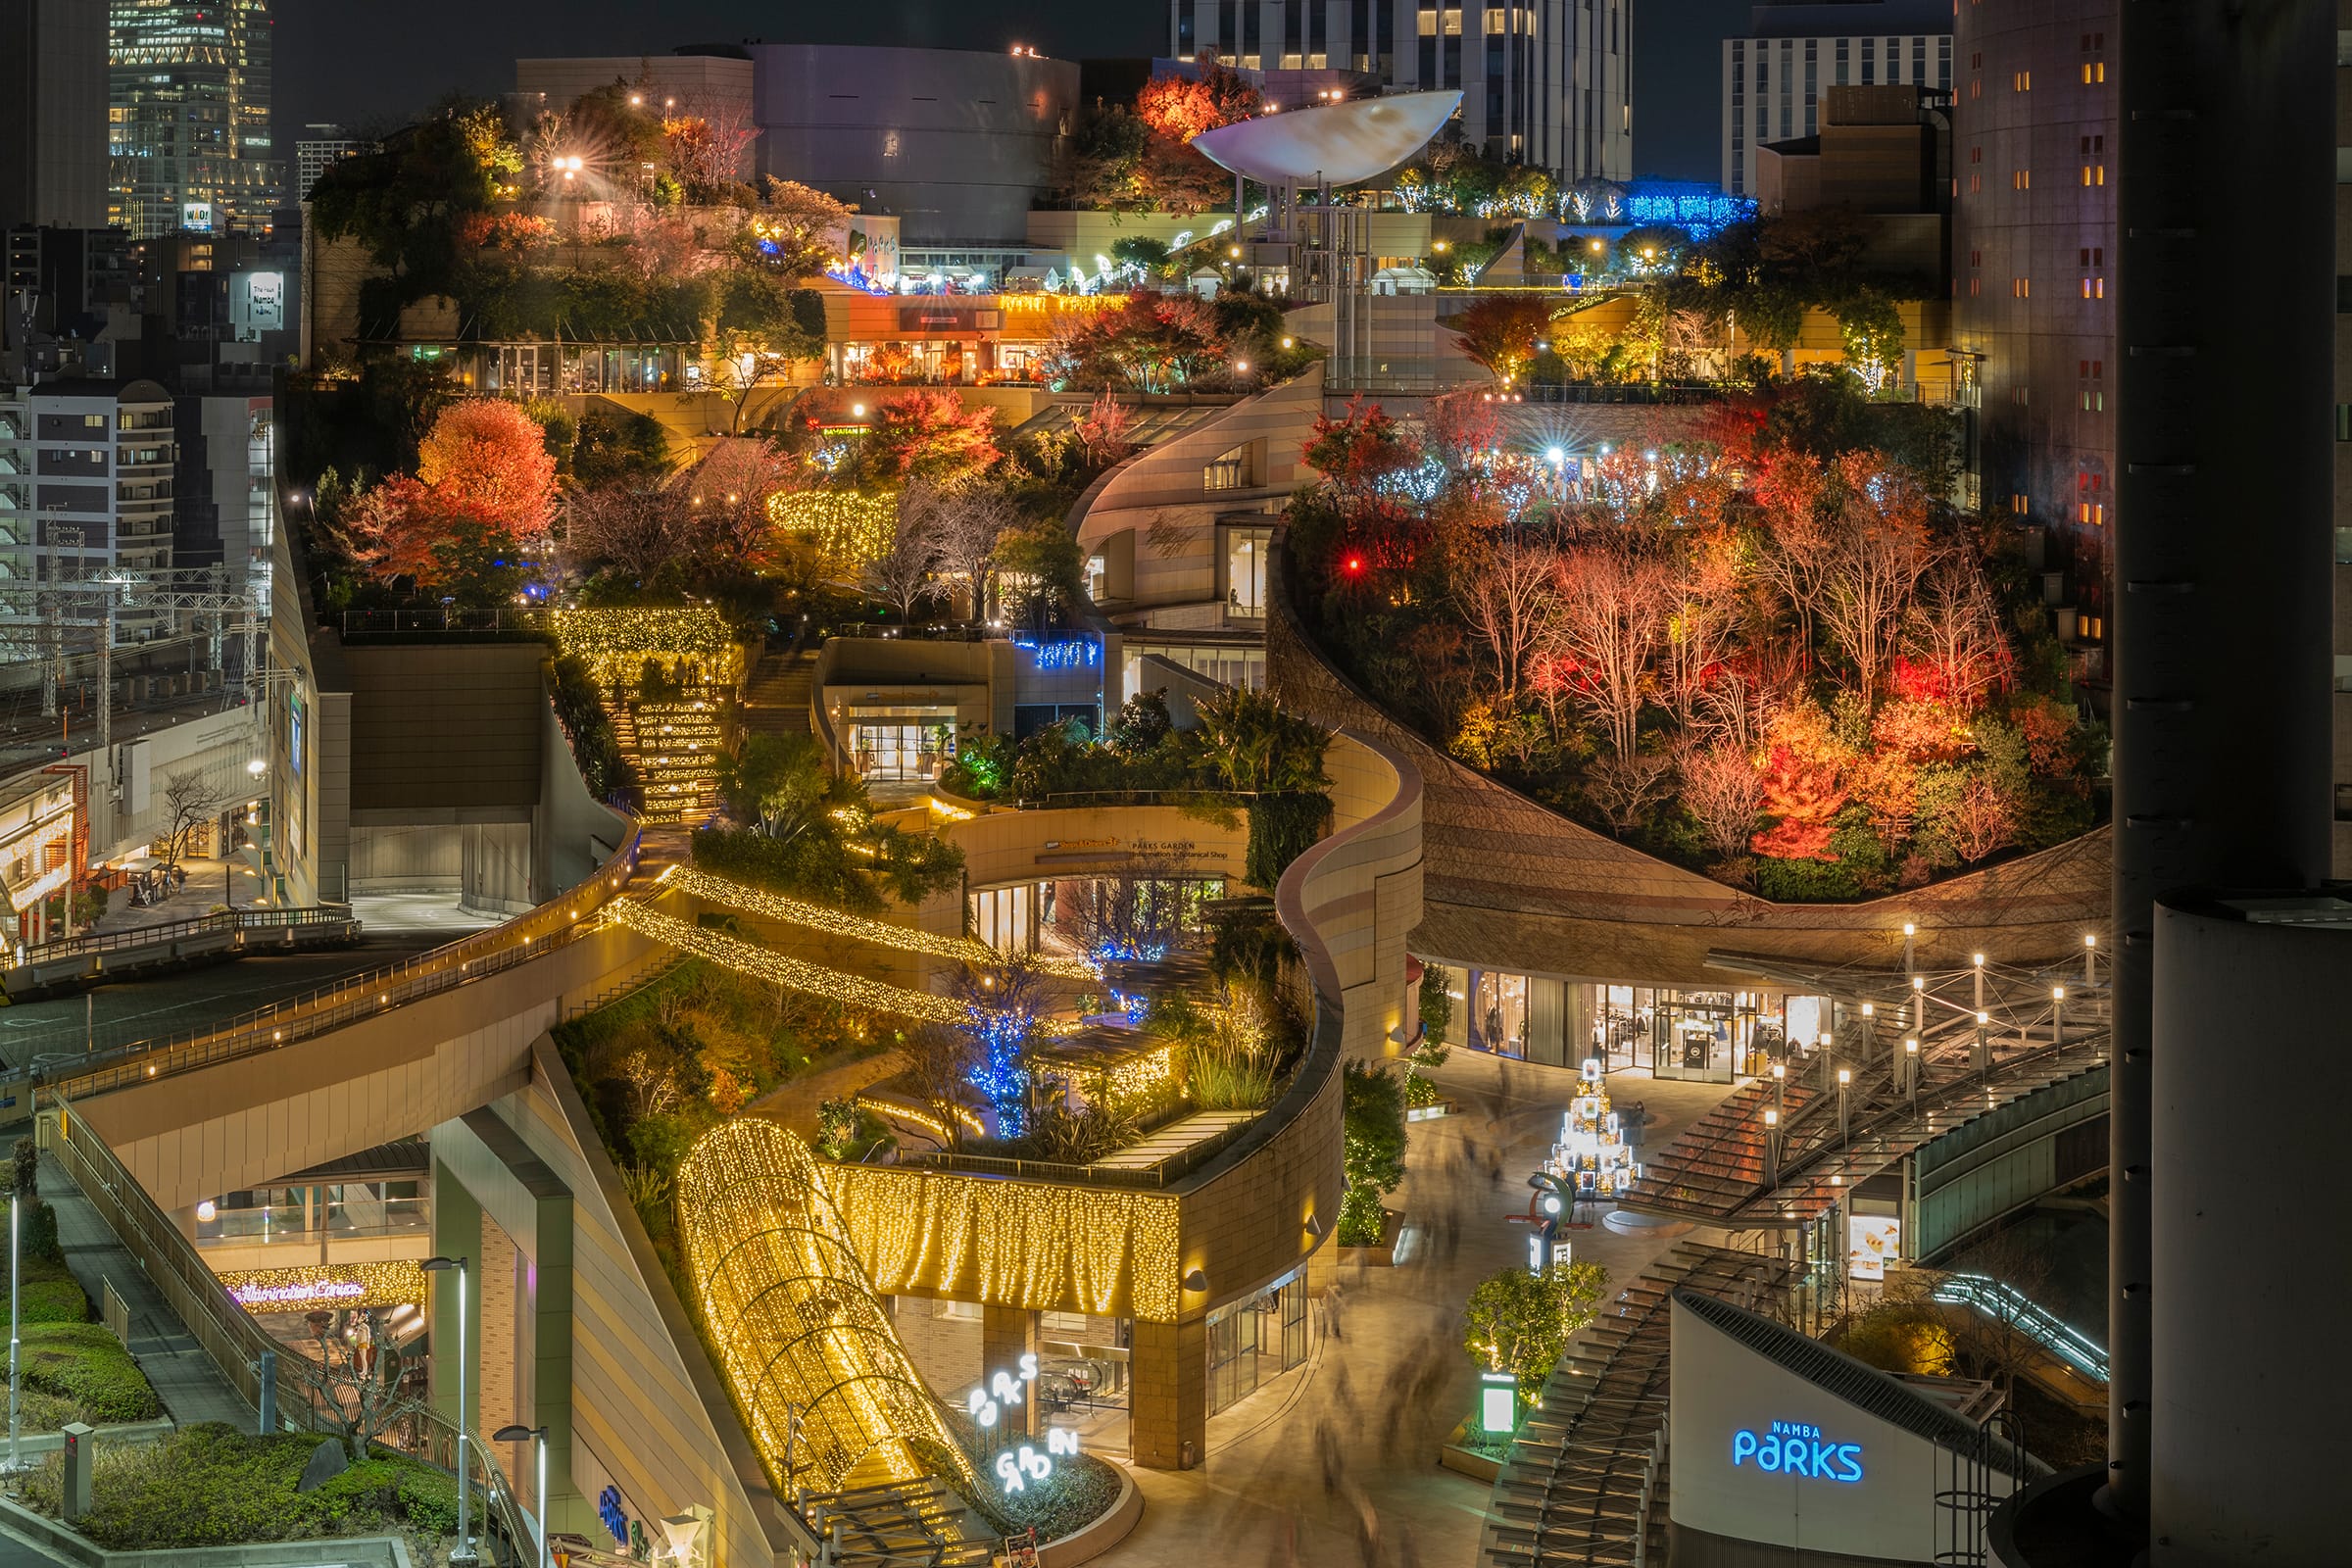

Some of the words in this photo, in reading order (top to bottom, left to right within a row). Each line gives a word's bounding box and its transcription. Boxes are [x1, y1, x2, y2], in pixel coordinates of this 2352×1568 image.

[1210, 851, 1228, 859] Shop
[1773, 1421, 1820, 1439] NAMBA
[997, 1428, 1078, 1493] GARDEN
